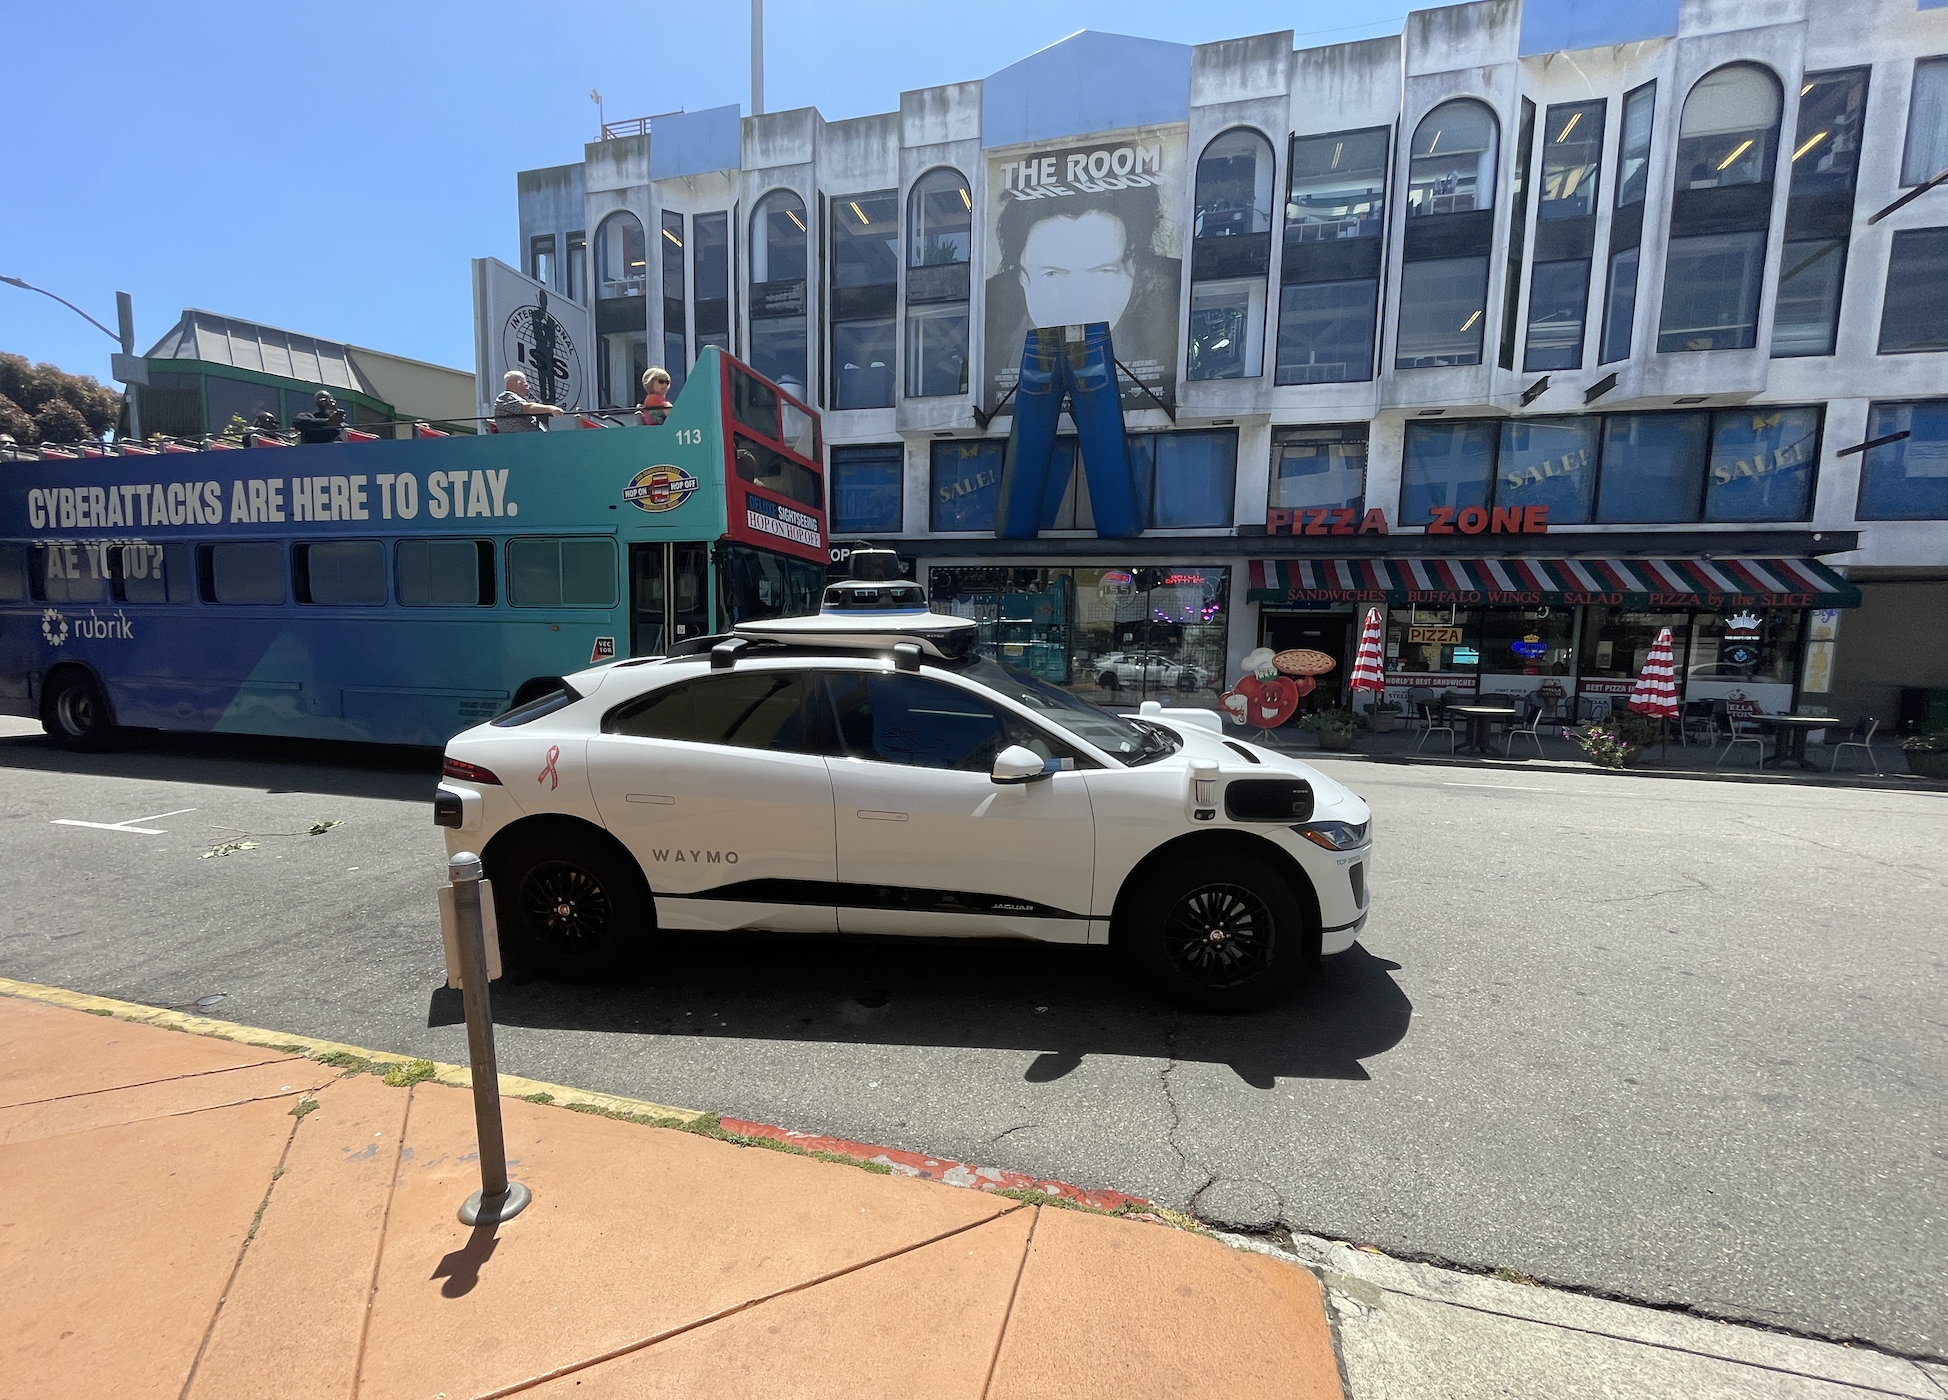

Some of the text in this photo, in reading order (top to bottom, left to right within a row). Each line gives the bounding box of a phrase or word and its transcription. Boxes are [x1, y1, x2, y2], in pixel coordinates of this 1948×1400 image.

[1000, 144, 1160, 191] THE ROOM
[510, 309, 575, 355] INTERONAL
[675, 428, 702, 445] 113
[1507, 449, 1587, 490] SALE!
[1714, 443, 1803, 486] SALE!
[28, 468, 518, 529] CYBERATTACKS ARE HERE TO STAY.
[624, 479, 696, 499] HOP ON HOP OFF
[938, 469, 995, 503] SALE!
[748, 494, 818, 532] DELUXE SIGHTSEEING
[1267, 506, 1549, 536] PIZZA ZONE
[749, 511, 820, 546] HOP ON HOP OFF
[829, 548, 851, 561] OP
[1287, 589, 1813, 607] SANDWICHES BUFFALO WINGS SALAD PIZZA by the SLICE
[74, 609, 134, 639] rubrik
[1410, 629, 1459, 642] PIZZA
[1386, 677, 1476, 687] WORLD'S BEST SANDWICHES
[1585, 684, 1604, 692] BEST
[1605, 684, 1627, 692] PIZZA
[1730, 703, 1753, 712] ELLA
[652, 848, 739, 864] WAYMO
[991, 903, 1034, 911] JAGUAR
